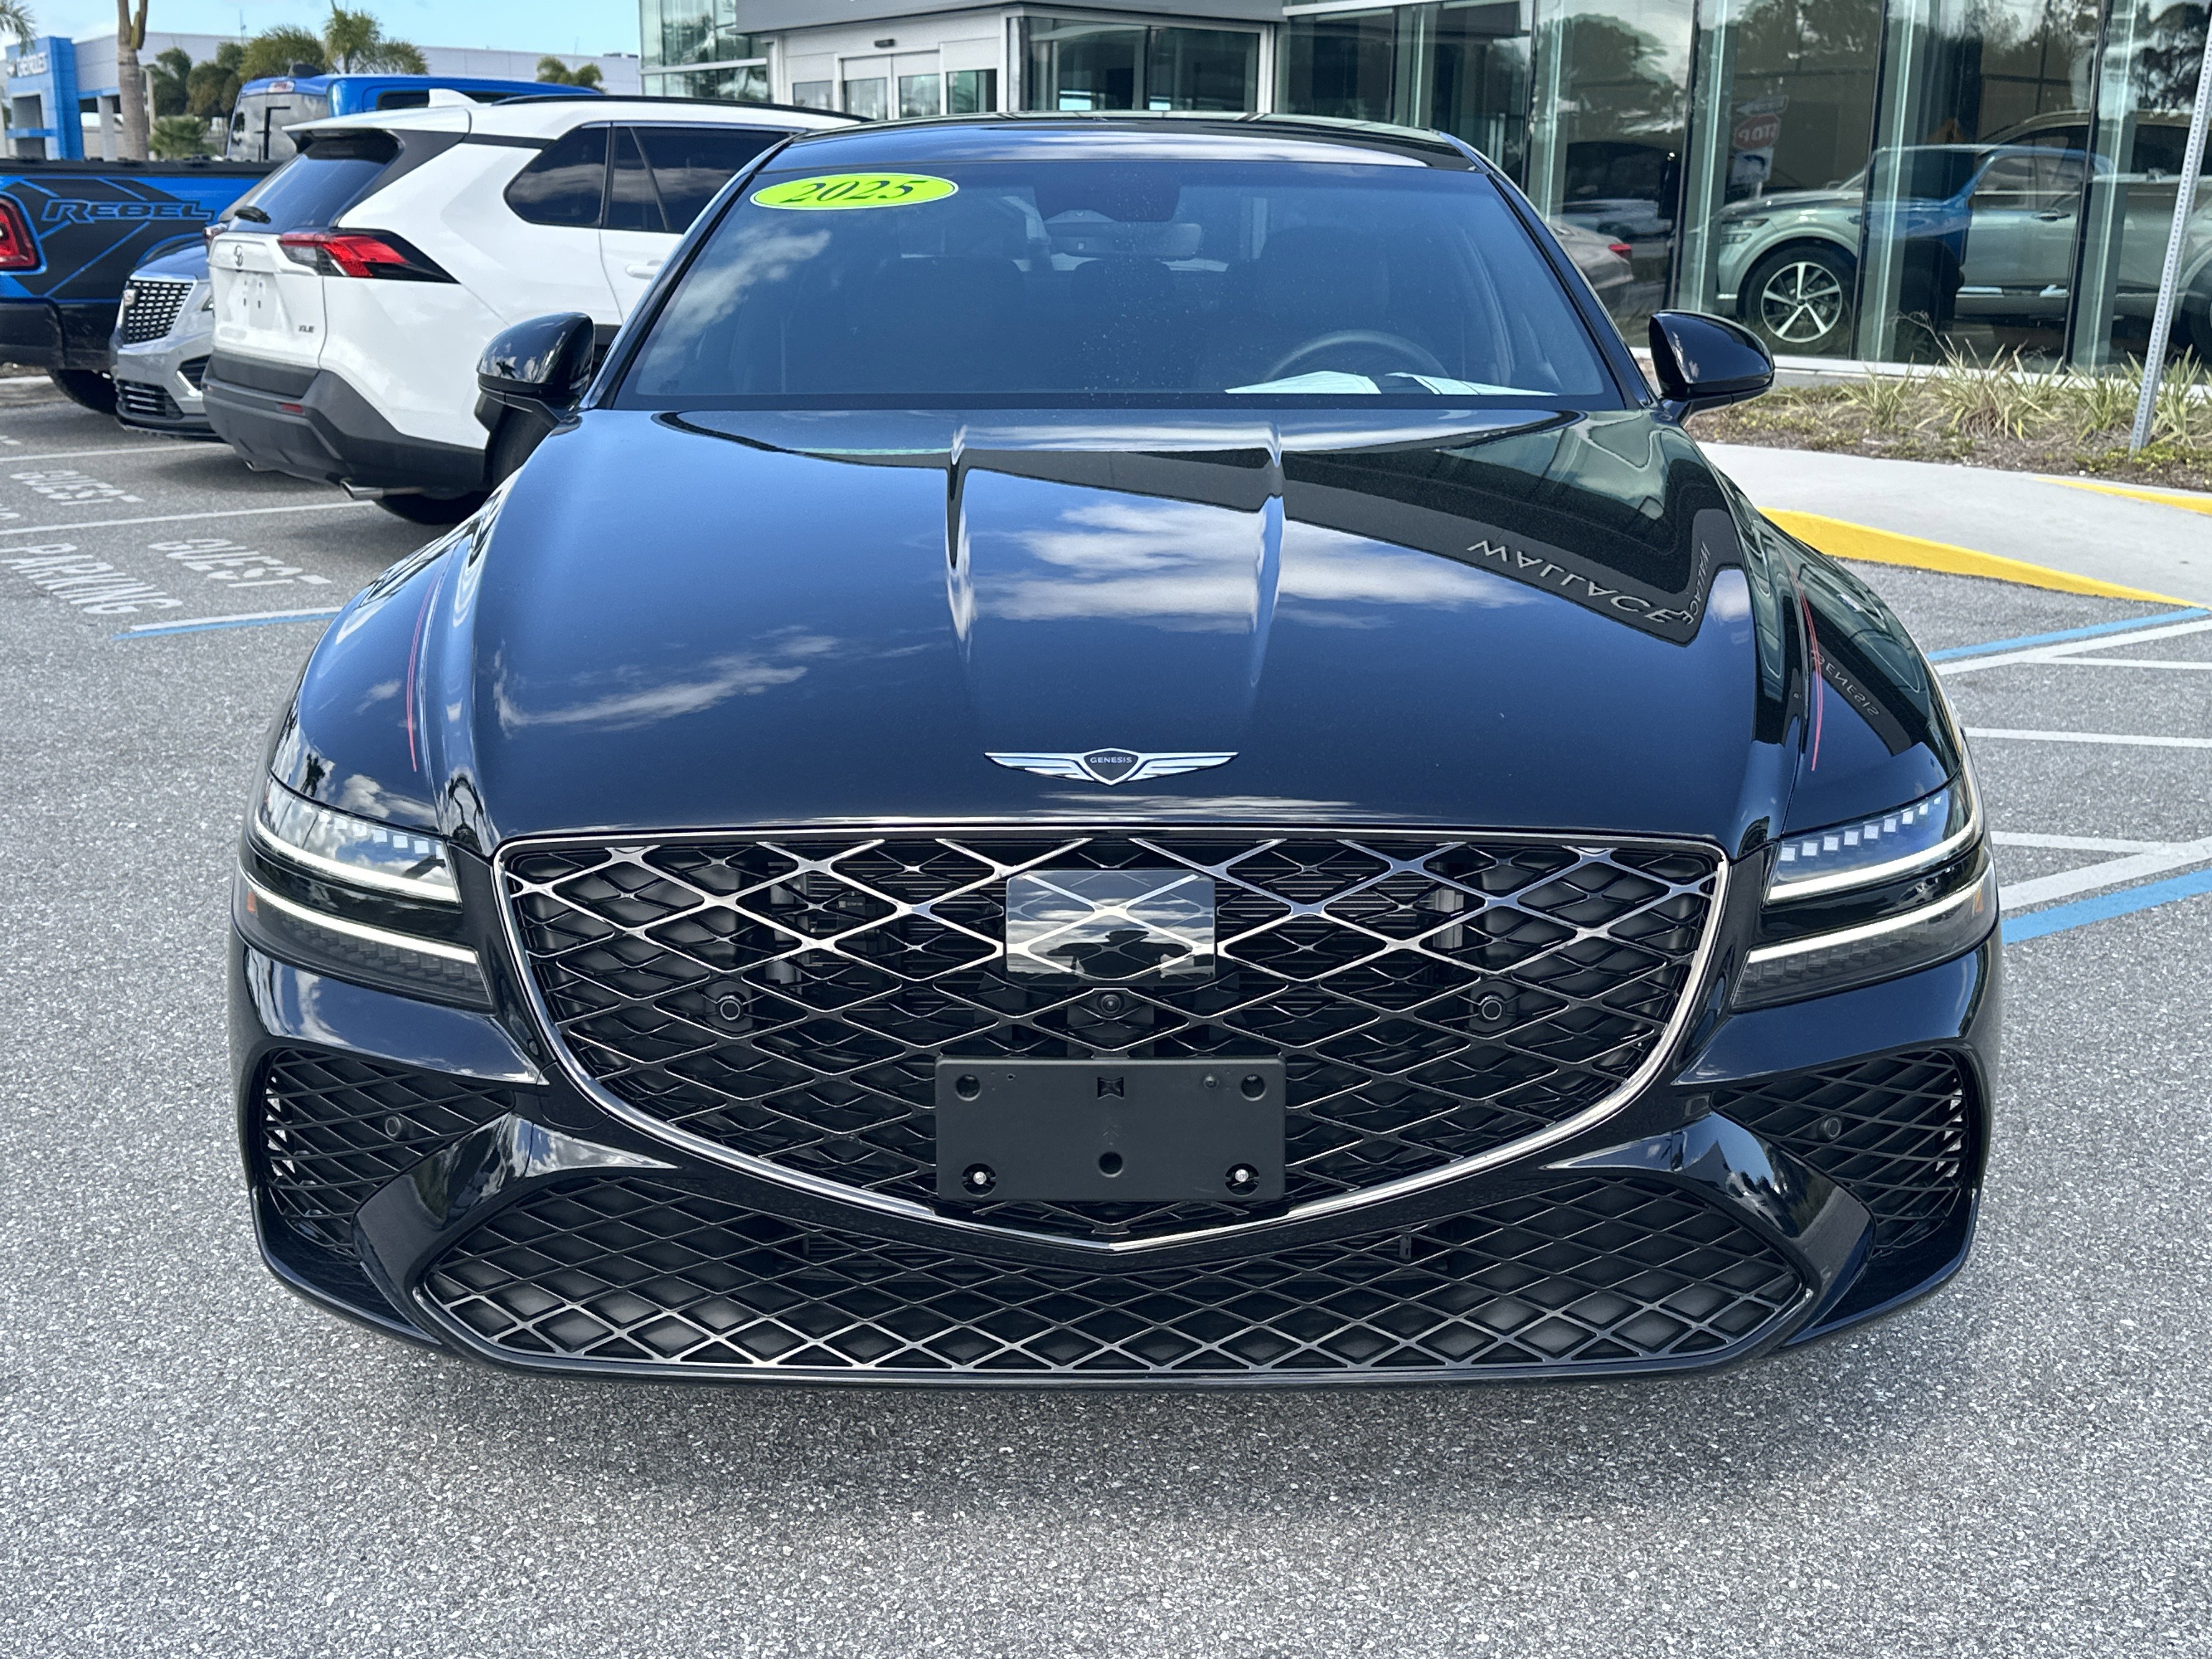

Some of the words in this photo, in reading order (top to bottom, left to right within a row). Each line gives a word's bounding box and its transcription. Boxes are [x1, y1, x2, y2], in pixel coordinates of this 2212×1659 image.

[778, 180, 929, 204] 2025
[41, 198, 215, 224] REBEL
[9, 470, 145, 506] GUEST
[0, 543, 183, 614] PARKING
[147, 538, 332, 588] GUEST
